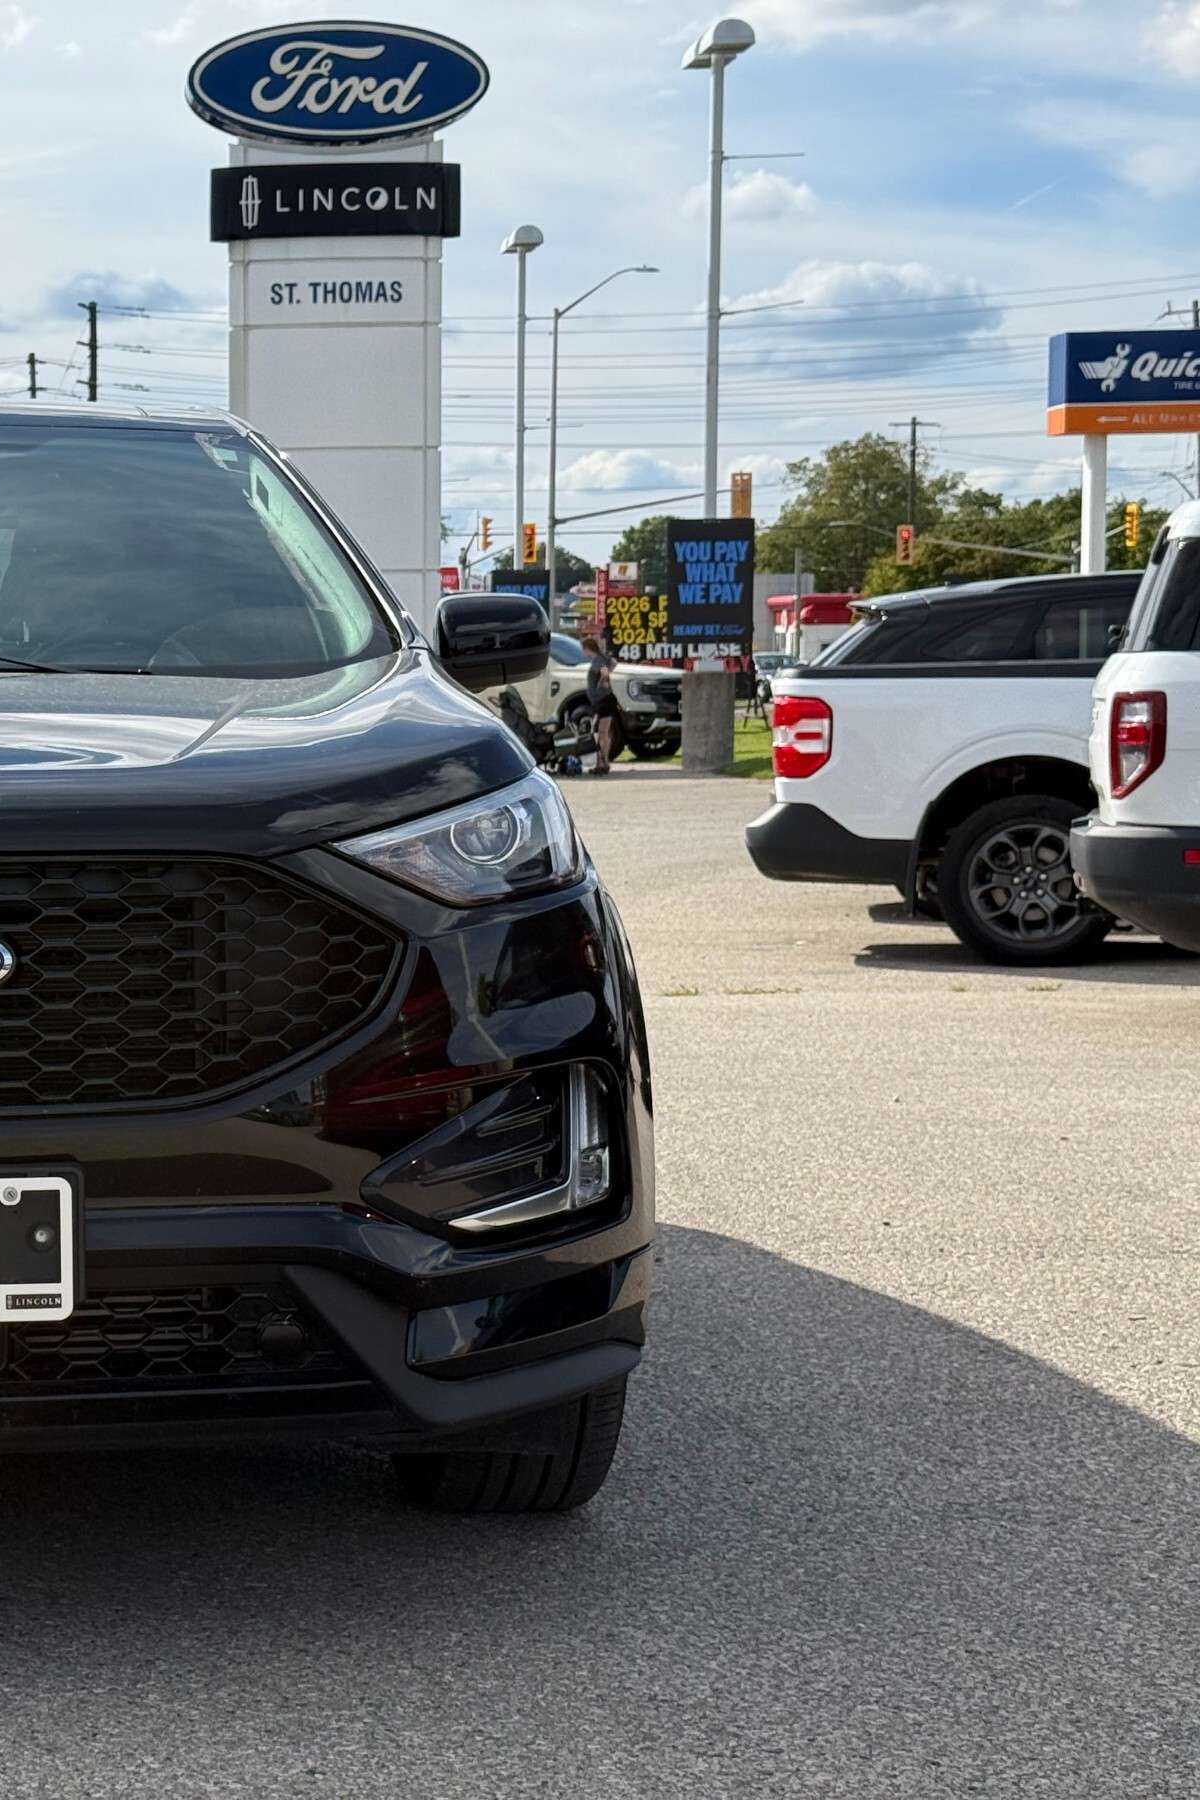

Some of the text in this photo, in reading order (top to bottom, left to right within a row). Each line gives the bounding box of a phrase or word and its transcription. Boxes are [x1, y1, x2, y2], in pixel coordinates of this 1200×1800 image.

[250, 40, 429, 114] Ford
[275, 186, 436, 212] LINCOLN
[270, 280, 404, 305] ST. THOMAS
[1130, 350, 1200, 382] Quic
[674, 540, 749, 562] YOU PAY
[685, 562, 738, 583] WHAT
[677, 583, 744, 604] WE PAY
[606, 595, 650, 614] 2026
[609, 612, 668, 629] 4X4 SP
[612, 629, 656, 645] 302A
[618, 644, 641, 661] 48
[646, 643, 682, 660] MTH
[15, 1296, 62, 1307] LINCOLN
